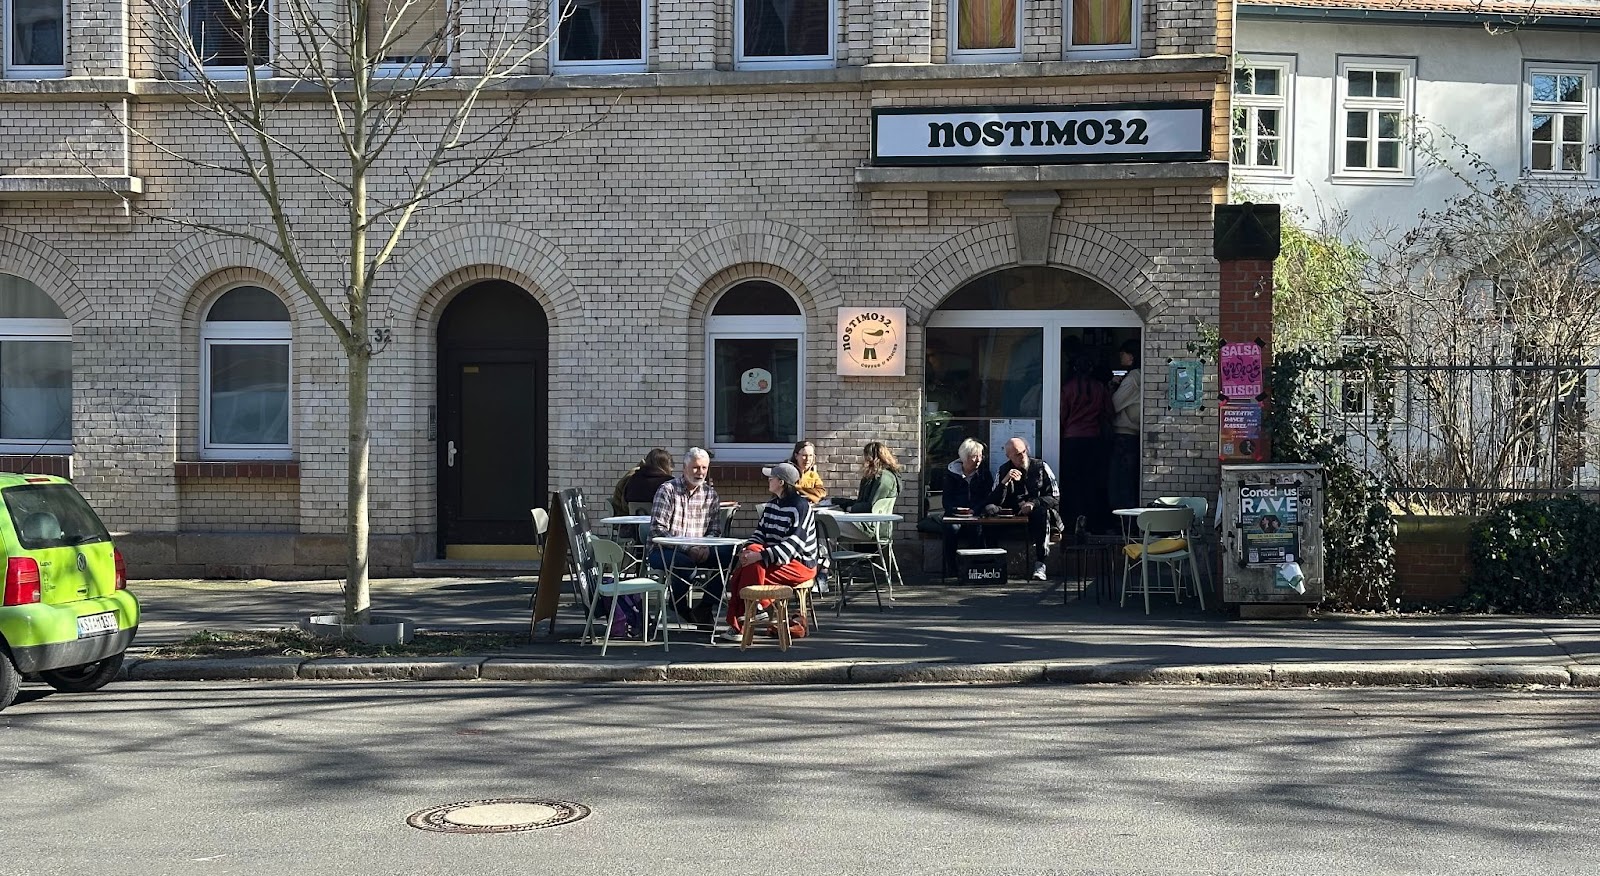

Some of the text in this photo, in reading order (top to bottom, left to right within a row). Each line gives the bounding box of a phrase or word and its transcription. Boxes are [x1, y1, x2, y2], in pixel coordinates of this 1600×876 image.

[1221, 344, 1260, 356] SALSA
[1223, 384, 1261, 395] DISCO
[1241, 497, 1298, 513] RAVE
